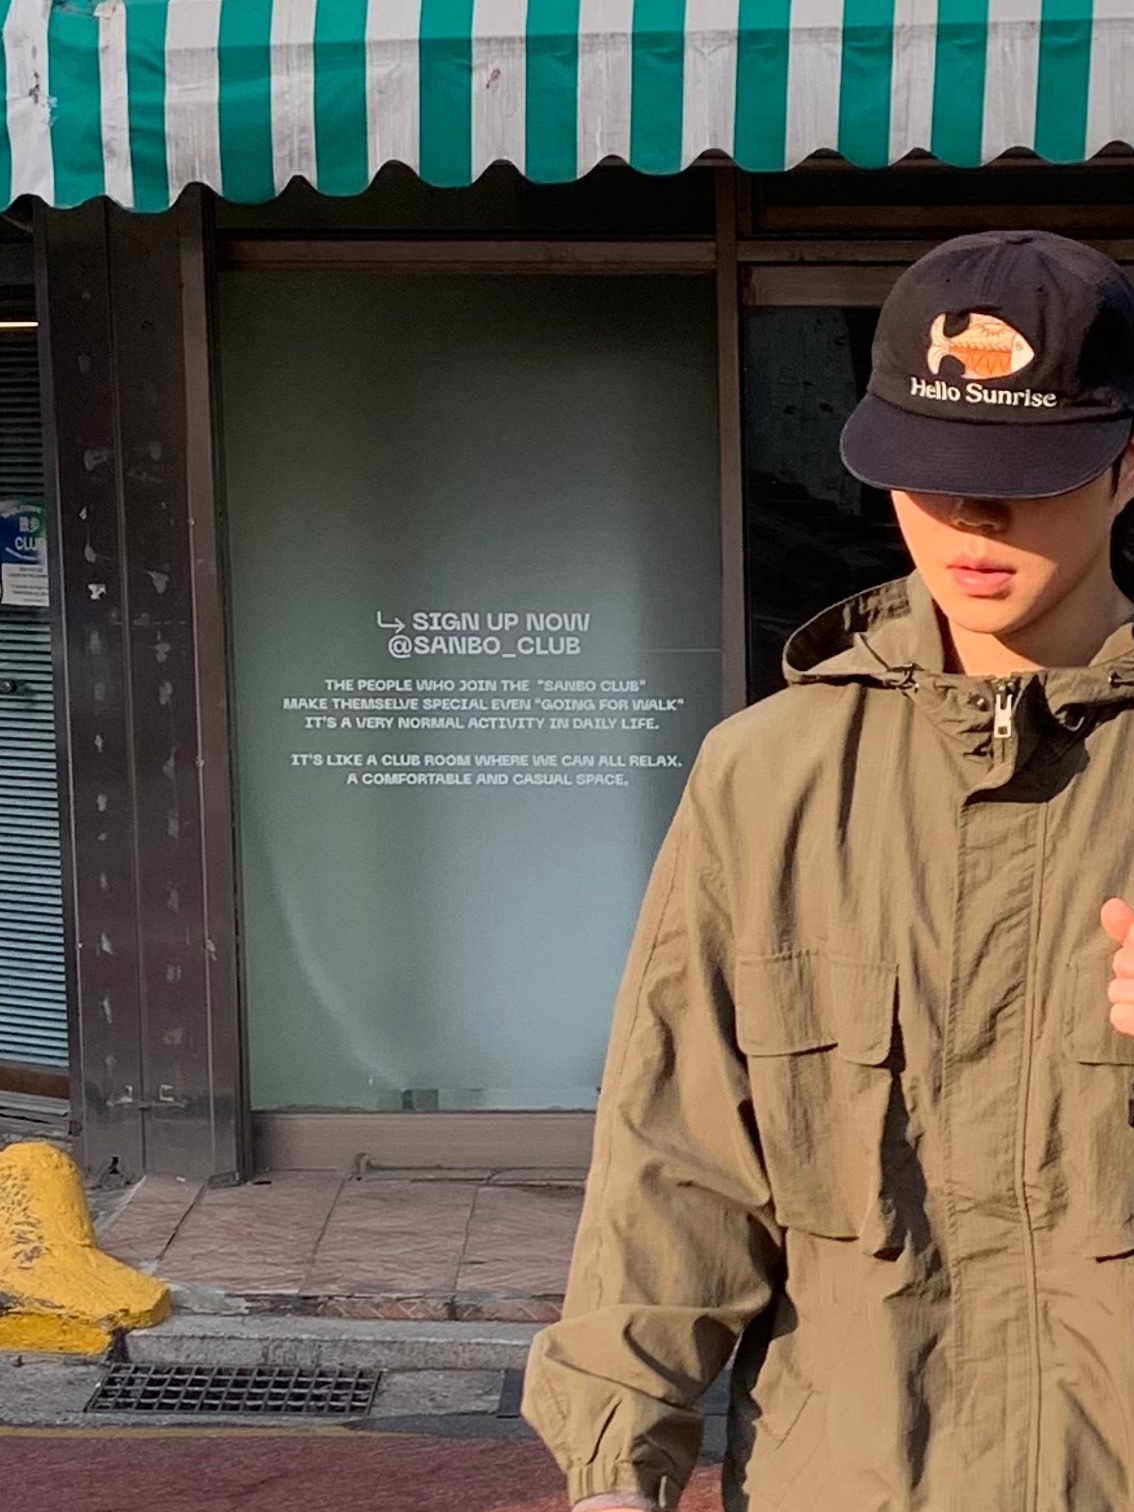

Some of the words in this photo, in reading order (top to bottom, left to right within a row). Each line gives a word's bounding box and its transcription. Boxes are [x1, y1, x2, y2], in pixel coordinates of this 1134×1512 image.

[910, 377, 960, 401] Hello
[965, 383, 1057, 407] Sunrise
[412, 612, 480, 632] SIGN
[486, 612, 519, 632] UP
[525, 612, 591, 632] NOW
[387, 634, 581, 659] @SANBO_CLUB
[324, 678, 355, 693] THE
[356, 678, 413, 693] PEOPLE
[415, 678, 456, 693] WHO
[458, 678, 497, 693] JOIN
[500, 678, 530, 693] THE
[282, 697, 329, 712] MAKE
[330, 697, 419, 712] THEMSELVE
[422, 697, 489, 712] SPECIAL
[491, 697, 532, 712] EVEN
[598, 697, 629, 712] FOR
[340, 716, 353, 730] A
[354, 716, 395, 730] VERY
[397, 716, 465, 730] NORMAL
[467, 716, 546, 730] ACTIVITY
[549, 716, 570, 730] IN
[572, 716, 618, 730] DAILY
[621, 716, 660, 730] LIFE.
[326, 753, 364, 768] LIKE
[365, 753, 379, 768] A
[380, 753, 422, 768] CLUB
[423, 753, 472, 768] ROOM
[473, 753, 530, 768] WHERE
[531, 753, 558, 768] WE
[561, 753, 595, 768] CAN
[597, 753, 627, 768] ALL
[628, 753, 683, 768] RELAX.
[346, 772, 359, 787] A
[361, 772, 473, 787] COMFORTABLE
[475, 772, 509, 787] AND
[512, 772, 573, 787] CASUAL
[575, 772, 629, 787] SPACE.
